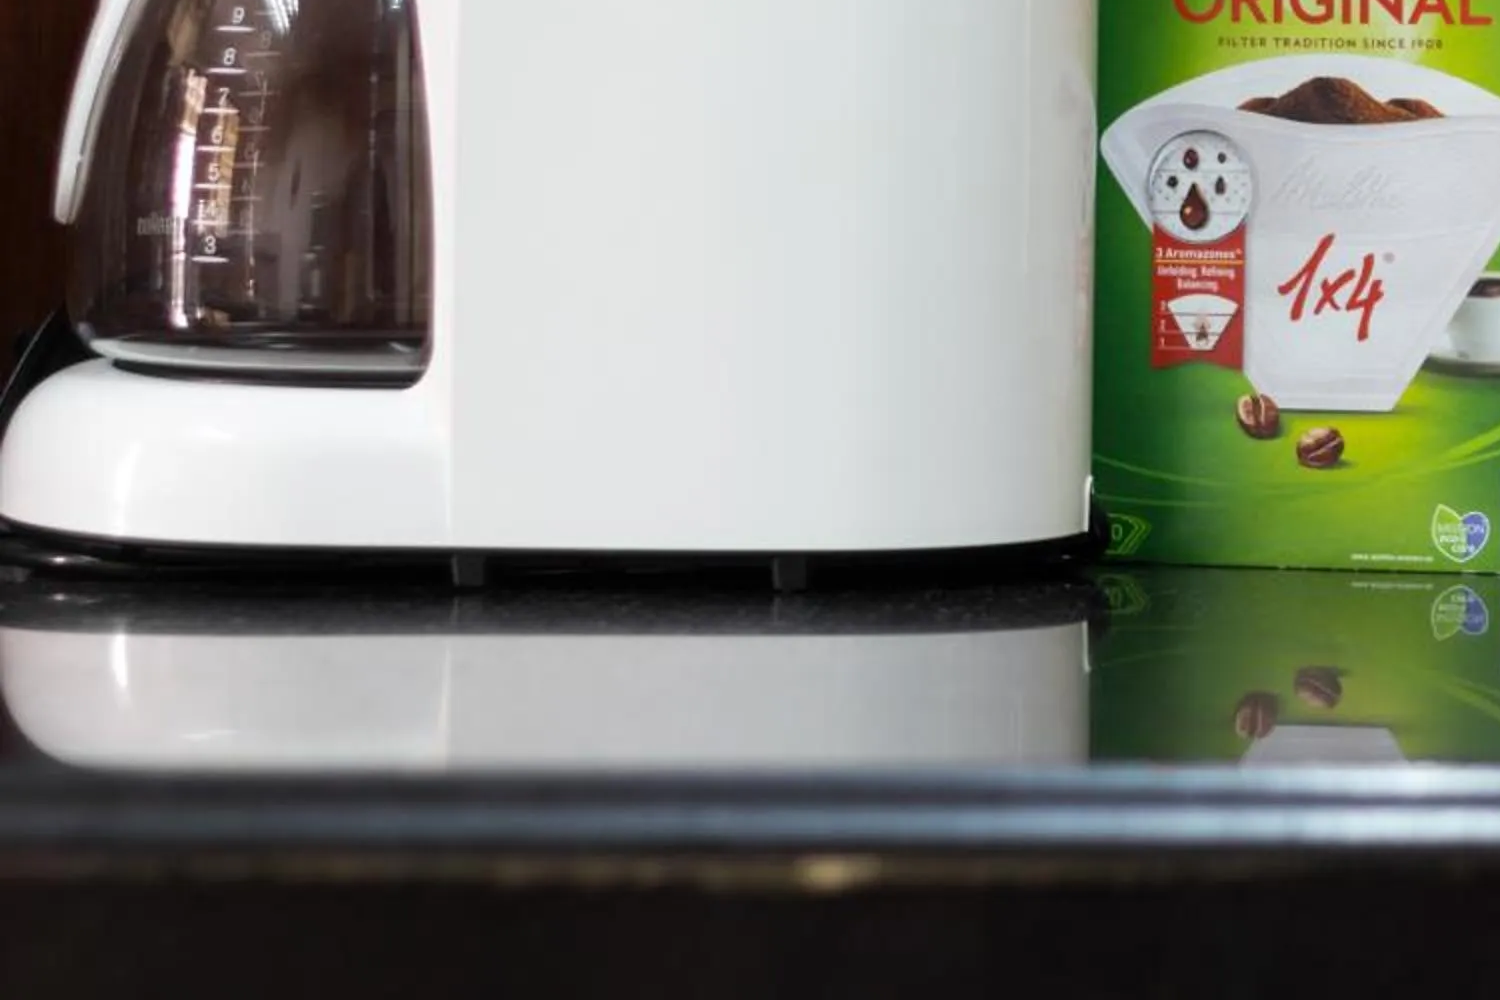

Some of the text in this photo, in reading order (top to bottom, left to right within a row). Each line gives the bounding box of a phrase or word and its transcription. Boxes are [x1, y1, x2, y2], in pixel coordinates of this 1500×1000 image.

[232, 6, 245, 25] 9
[1217, 36, 1443, 50] FILTER TRADITION SINCE 1908
[223, 47, 237, 66] 8
[1277, 232, 1385, 342] 1x4
